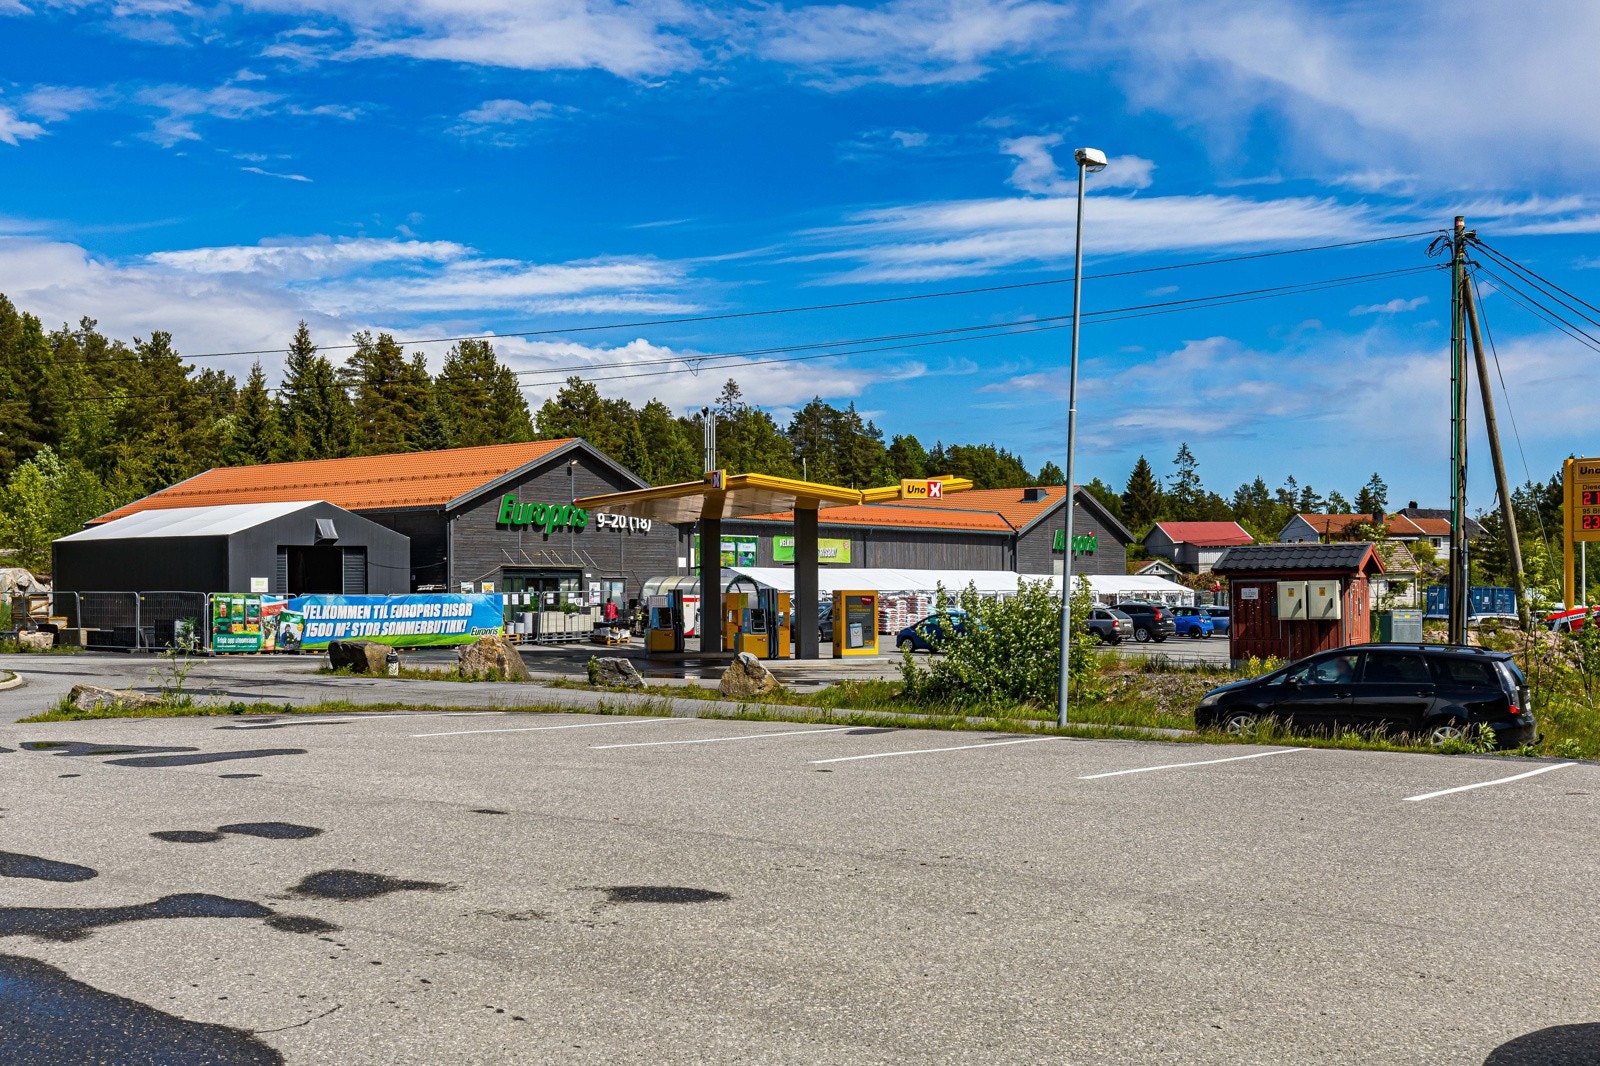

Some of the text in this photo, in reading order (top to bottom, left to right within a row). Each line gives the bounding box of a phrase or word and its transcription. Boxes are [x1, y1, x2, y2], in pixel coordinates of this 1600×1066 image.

[907, 482, 941, 497] Uno X
[498, 494, 590, 535] Europris
[1052, 529, 1099, 557] Euopris
[303, 602, 474, 620] VELKOMMEN TIL EUROPRIS RISØR
[305, 622, 335, 637] 1500
[350, 621, 381, 636] STOR
[380, 619, 468, 635] SOMMERBUTIKK!
